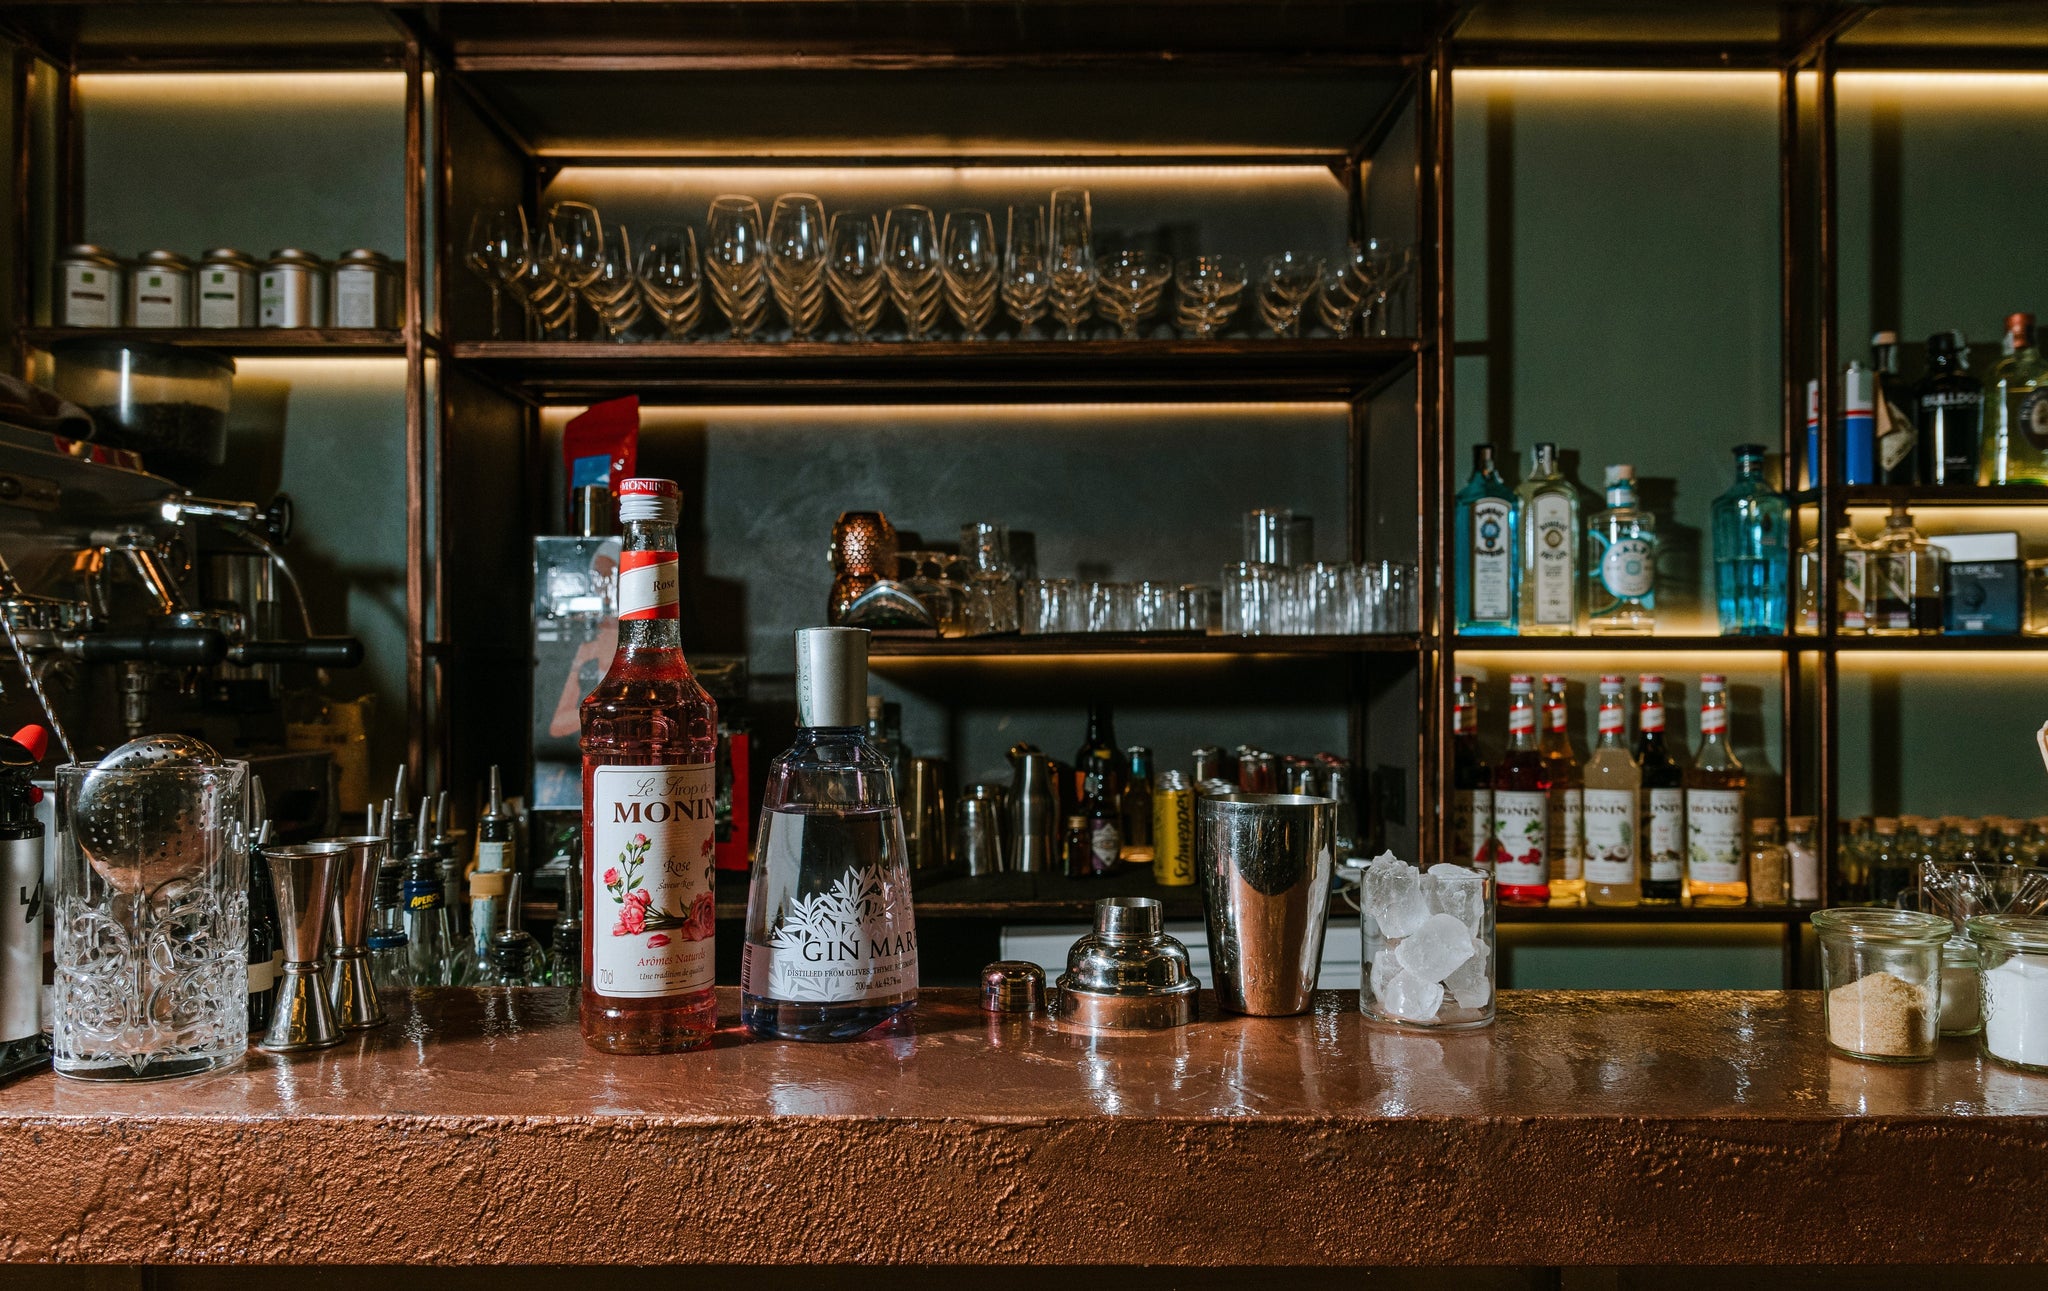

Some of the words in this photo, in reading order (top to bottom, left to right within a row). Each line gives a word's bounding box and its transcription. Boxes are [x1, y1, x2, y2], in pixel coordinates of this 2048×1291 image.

[653, 578, 675, 592] Rose
[628, 777, 656, 797] Le
[659, 776, 699, 799] Sirop
[613, 797, 714, 823] MONIN
[1174, 791, 1191, 879] Schweppes
[663, 855, 691, 877] Rose
[803, 939, 861, 962] GIN
[787, 969, 823, 978] DISTILLED
[825, 969, 845, 978] FROM
